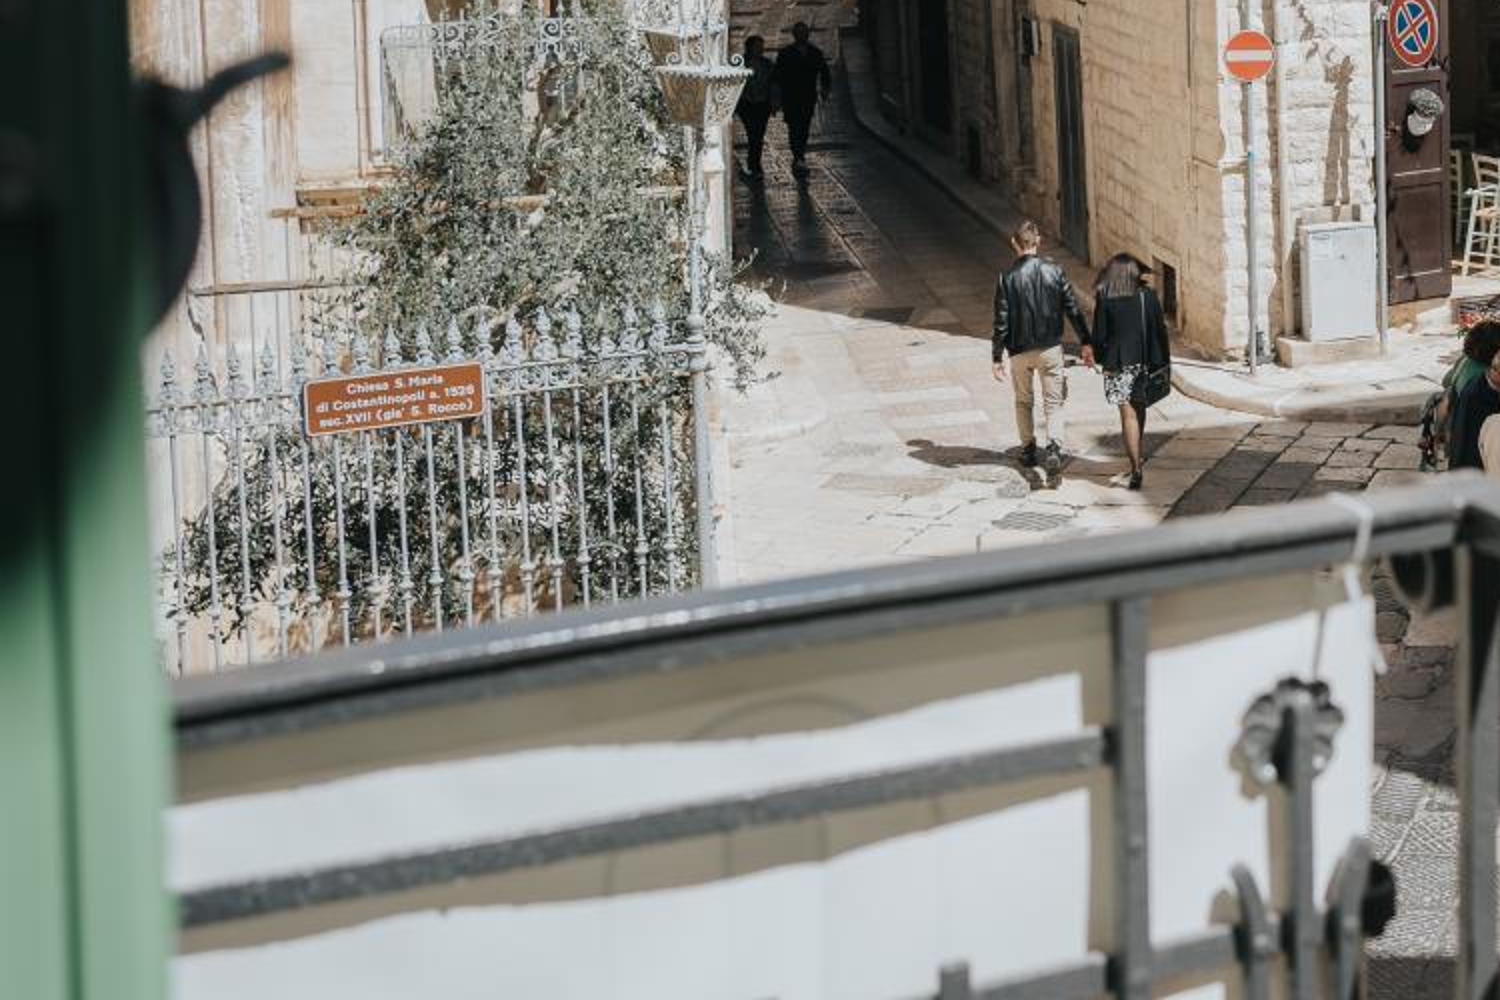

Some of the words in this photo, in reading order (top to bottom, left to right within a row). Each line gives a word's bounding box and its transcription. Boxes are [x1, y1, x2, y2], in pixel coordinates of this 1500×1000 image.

[347, 382, 389, 395] Chiesa
[408, 375, 443, 387] Maria
[316, 402, 329, 413] di
[333, 390, 425, 411] Costantinopoli
[427, 398, 473, 414] Rocco)
